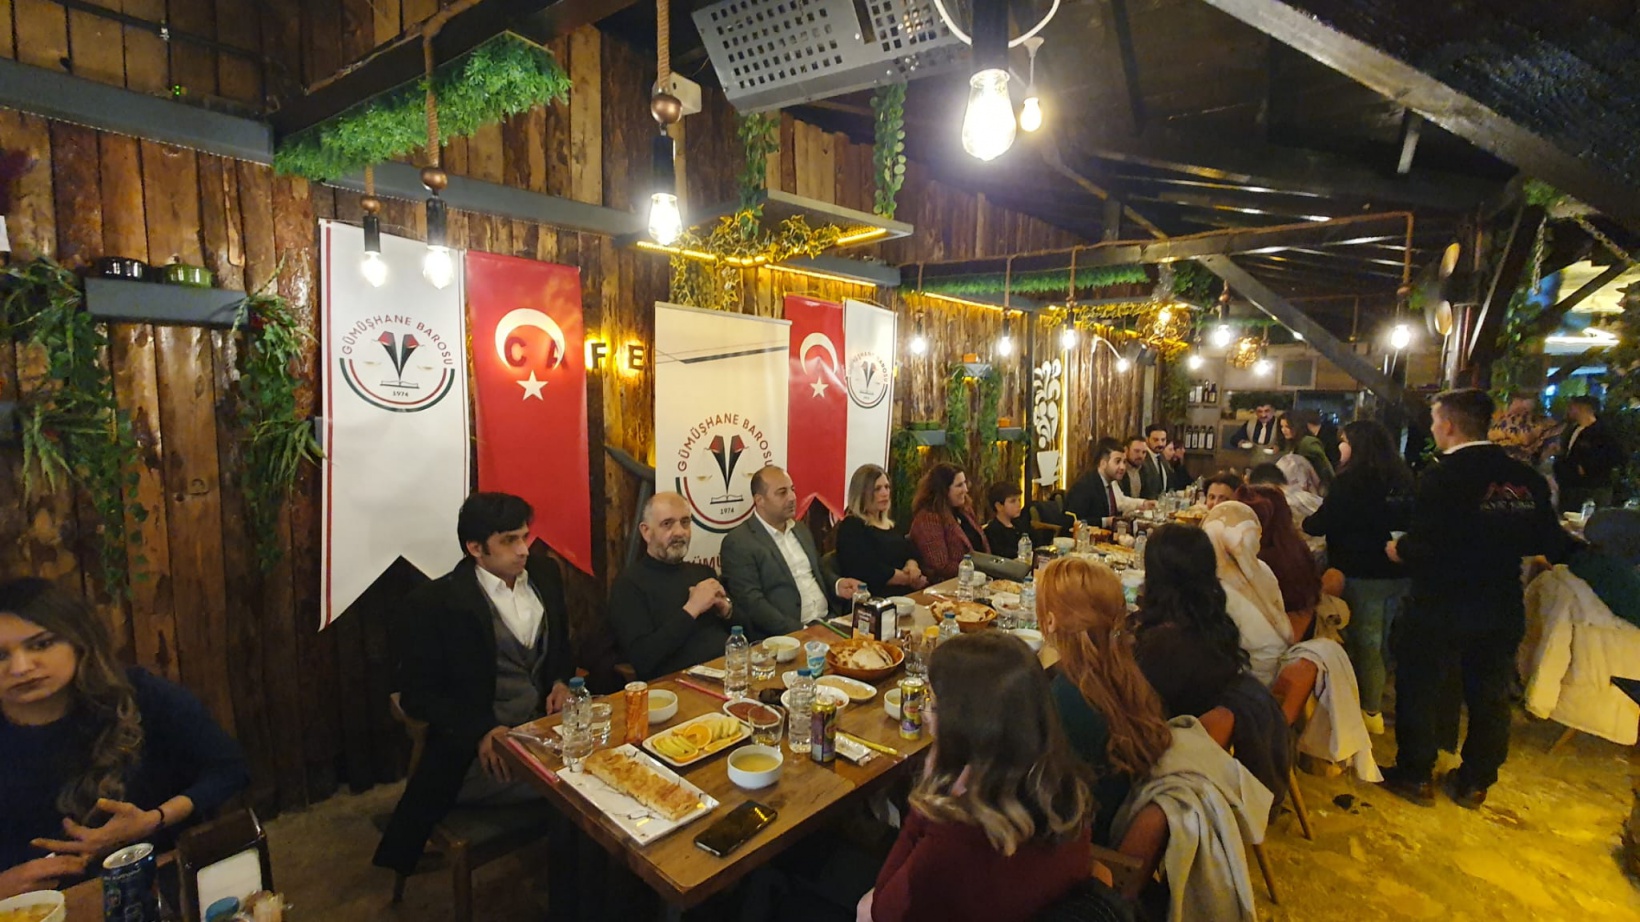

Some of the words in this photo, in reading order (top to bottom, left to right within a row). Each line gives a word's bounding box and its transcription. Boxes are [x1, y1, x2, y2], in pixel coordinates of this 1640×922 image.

[342, 314, 412, 355] GÜMÜŞHANE
[416, 322, 453, 365] BAROSU
[504, 337, 644, 371] CAFE
[678, 413, 740, 472] GÜMÜŞHANE
[742, 418, 774, 467] BAROSU
[720, 507, 734, 515] 1974
